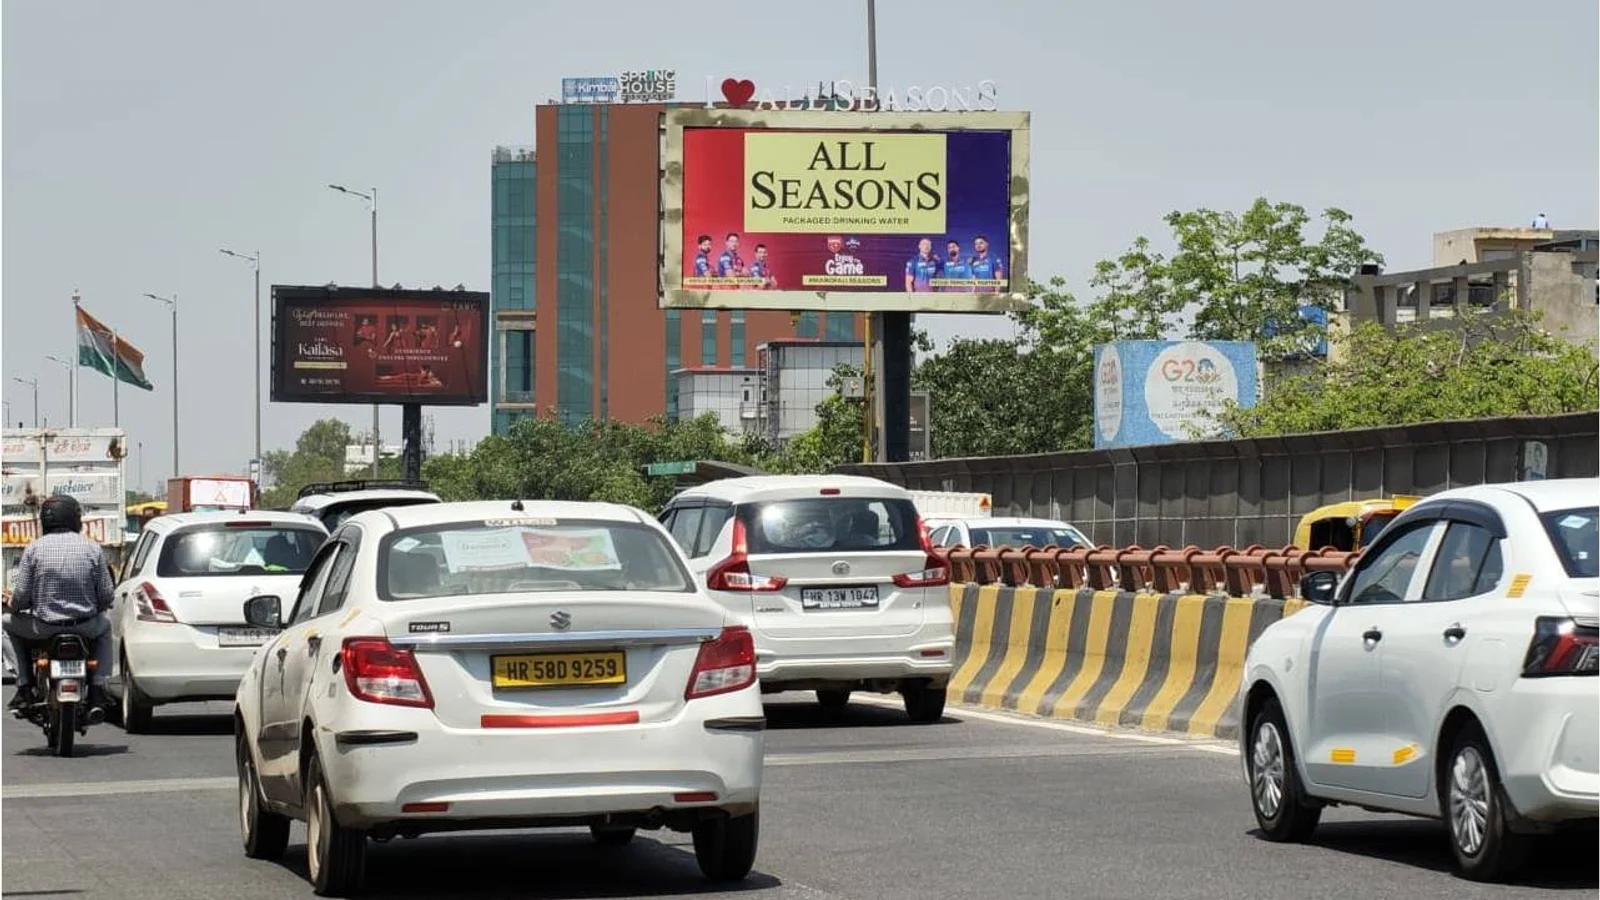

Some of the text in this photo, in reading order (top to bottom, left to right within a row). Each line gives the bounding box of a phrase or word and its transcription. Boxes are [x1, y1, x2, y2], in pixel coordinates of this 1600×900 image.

[620, 70, 675, 81] SPRING
[620, 81, 674, 93] HOUSE
[755, 86, 829, 110] ALL
[830, 79, 997, 111] SEASONS
[807, 141, 887, 171] ALL
[751, 171, 942, 210] SEASONS
[783, 216, 910, 225] PACKAGED DRINKING WATER
[825, 259, 864, 275] Game
[507, 658, 617, 681] HR 58D 9259
